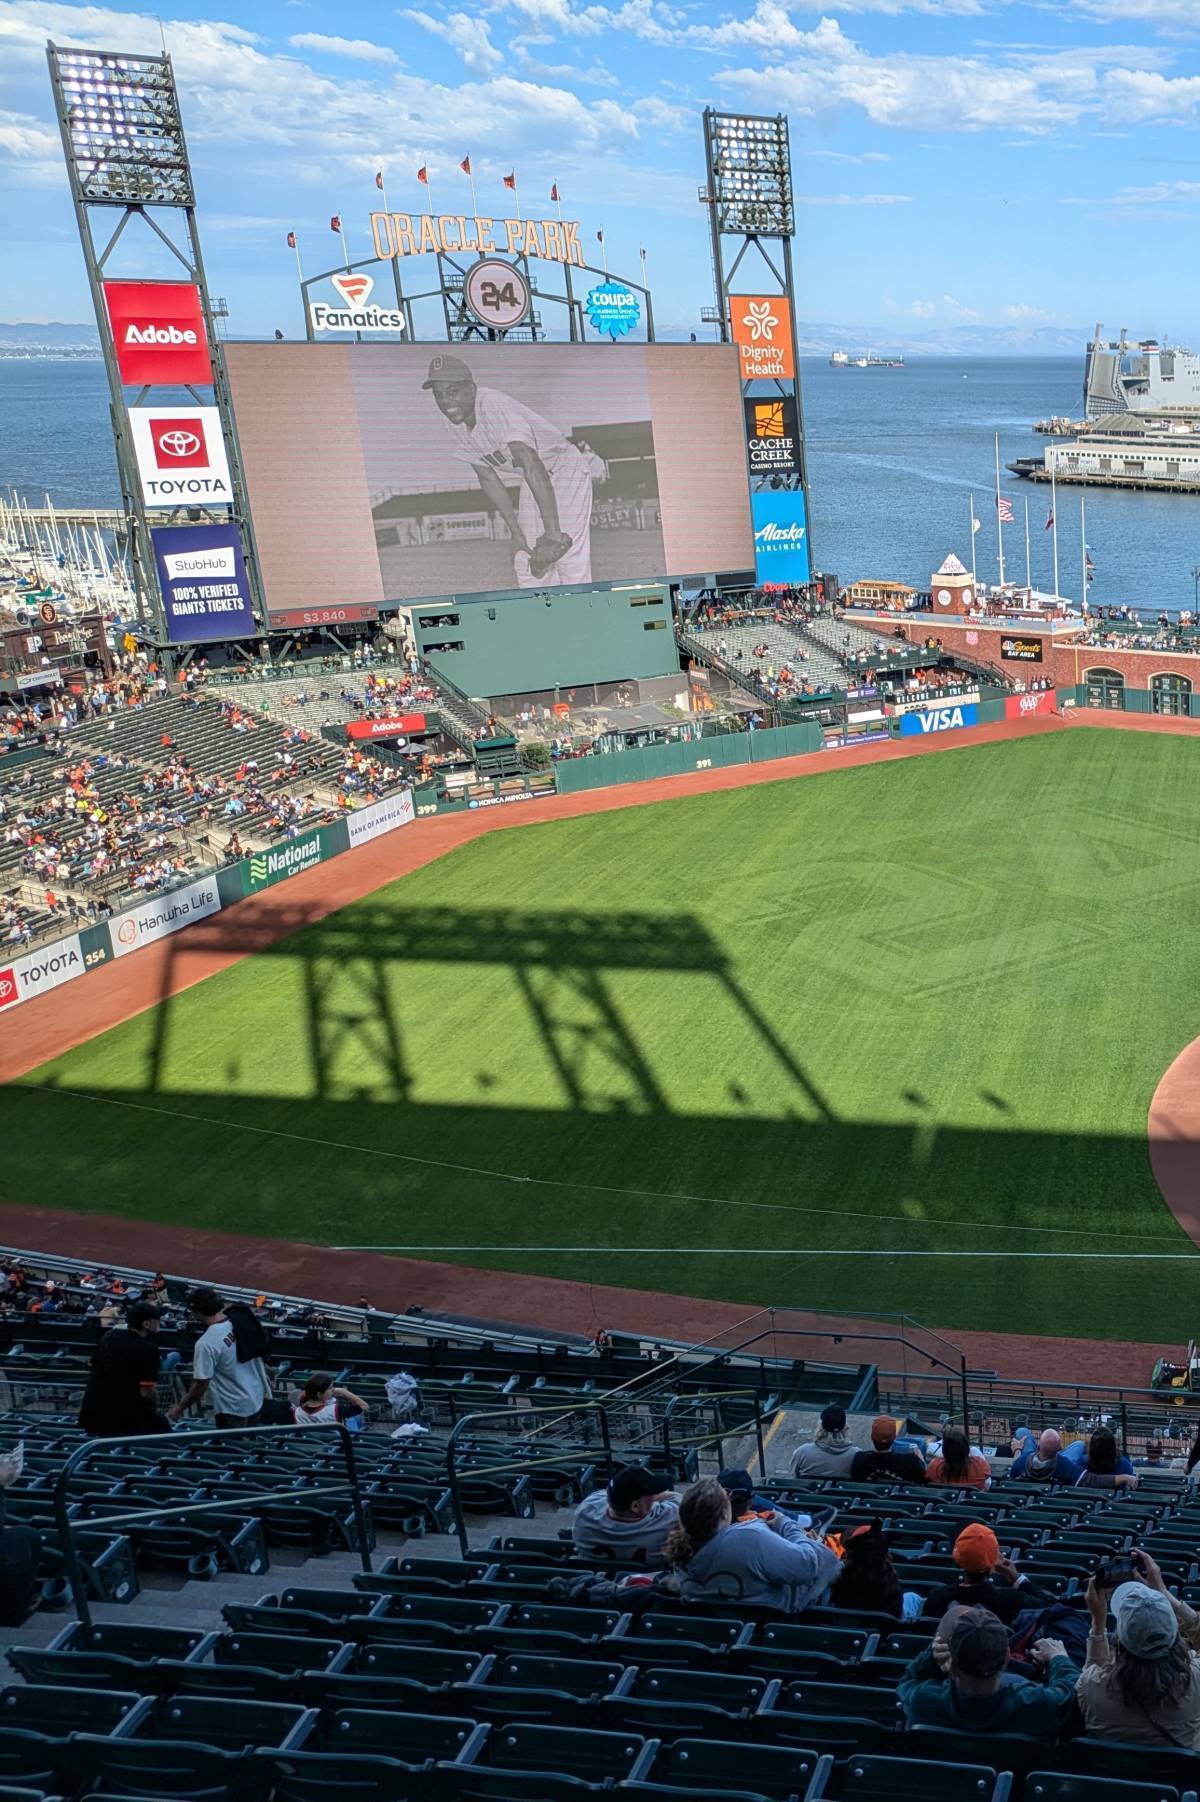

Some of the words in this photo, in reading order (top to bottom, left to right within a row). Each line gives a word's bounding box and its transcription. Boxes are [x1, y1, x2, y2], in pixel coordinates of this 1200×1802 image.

[370, 212, 495, 260] ORACLE
[504, 220, 586, 267] PARK
[480, 281, 521, 311] 24
[592, 293, 635, 310] coupa
[314, 306, 401, 328] Fanatics
[124, 324, 198, 345] Adobe
[741, 345, 784, 362] Dignity
[745, 362, 784, 375] Health
[748, 438, 794, 450] CACHE
[750, 450, 793, 461] CREEK
[147, 479, 227, 495] TOYOTA
[754, 522, 804, 542] Alaska
[755, 543, 801, 553] AIRLINES
[175, 558, 226, 571] StubHub
[172, 587, 199, 601] 100%
[198, 584, 239, 598] VERIFIED
[172, 601, 206, 616] GIANTS
[206, 597, 244, 612] TICKETS
[303, 611, 346, 624] $3,840
[1014, 641, 1041, 653] Sports
[896, 692, 929, 703] WELCOME
[967, 684, 979, 693] 415
[1021, 696, 1037, 708] AAA
[372, 721, 403, 733] Adobe
[916, 707, 964, 733] VISA
[695, 758, 713, 769] 391
[478, 797, 505, 807] KONICA
[504, 791, 534, 803] MINOLTA
[417, 804, 438, 815] 399
[350, 824, 367, 837] BANK
[367, 821, 375, 829] OF
[375, 810, 401, 826] AMERICA
[268, 834, 320, 874] National
[287, 865, 299, 876] Car
[300, 854, 320, 869] Rental
[139, 903, 189, 933] Hanwha
[191, 891, 214, 909] Life
[85, 948, 106, 966] 354
[20, 950, 79, 986] TOYOTA
